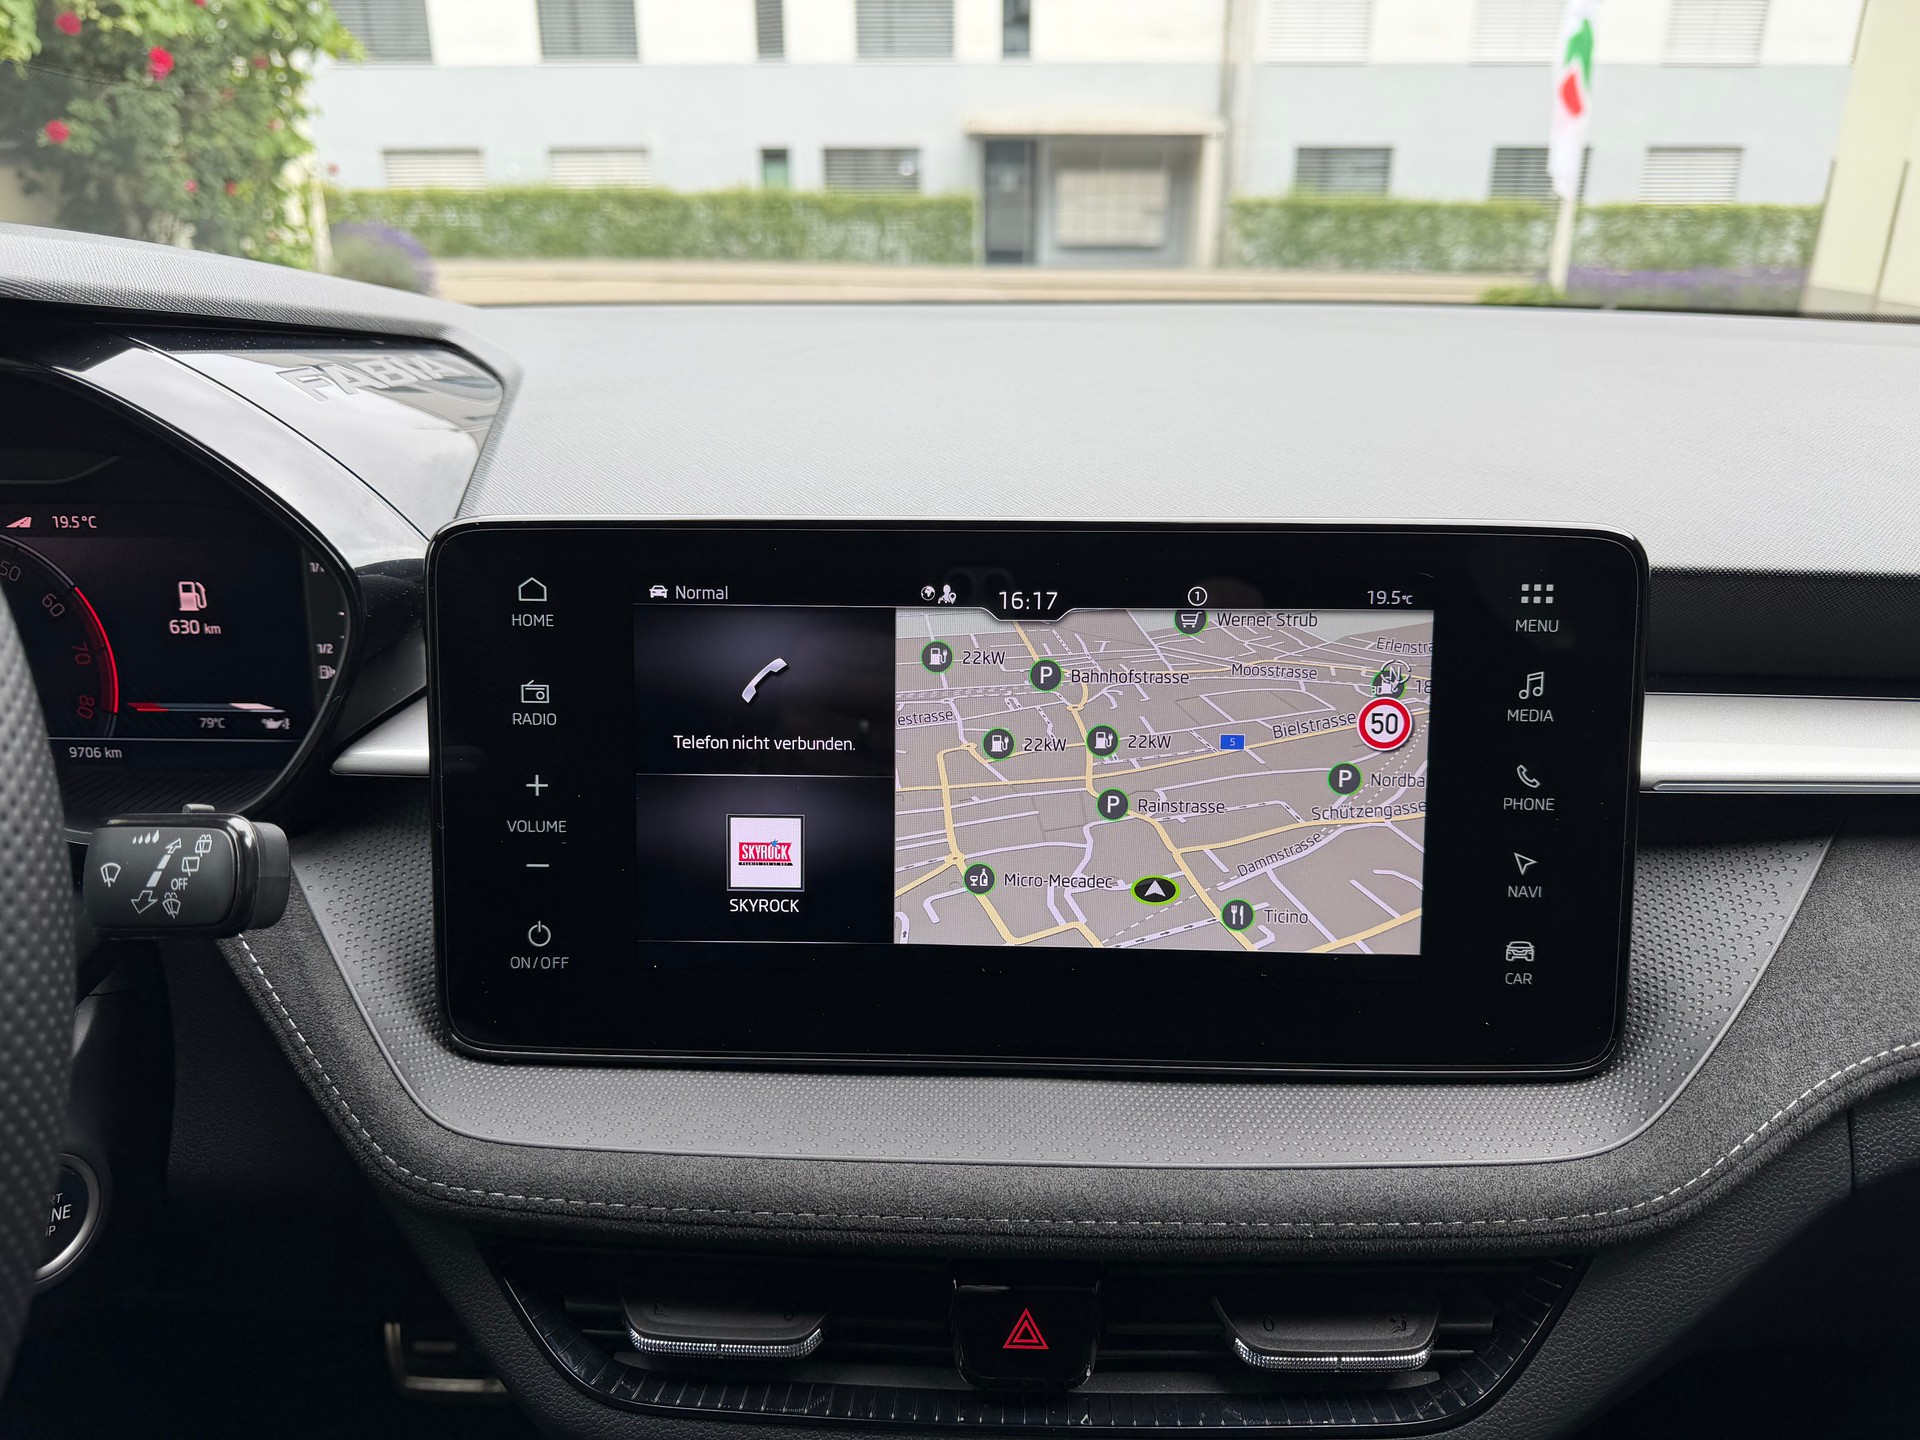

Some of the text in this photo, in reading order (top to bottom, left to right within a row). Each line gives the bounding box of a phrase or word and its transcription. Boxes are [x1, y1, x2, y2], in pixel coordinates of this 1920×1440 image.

[275, 355, 466, 402] FABIA
[52, 515, 97, 529] 19.5°C
[675, 584, 729, 601] Normal
[999, 591, 1058, 610] 16:17
[41, 593, 66, 617] 60
[511, 614, 555, 628] HOME
[1217, 611, 1318, 627] Werner Strub
[1515, 619, 1559, 633] MENU
[168, 620, 222, 635] 630 km
[71, 642, 92, 665] 70
[316, 643, 334, 654] 1/2
[962, 650, 1006, 666] 22kW
[1039, 667, 1053, 683] P
[1071, 668, 1189, 686] Bahnhofstrasse
[1231, 663, 1318, 680] Moosstrasse
[77, 695, 95, 719] 80
[200, 717, 226, 729] 79°C
[512, 713, 557, 727] RADIO
[897, 710, 954, 726] estrasse
[1370, 711, 1399, 735] 50
[1507, 709, 1554, 723] MEDIA
[1271, 712, 1358, 739] Bielstrasse
[673, 734, 857, 752] Telefon nicht verbunden.
[1023, 737, 1067, 752] 22kW
[1127, 734, 1172, 750] 22kW
[69, 747, 122, 760] 9706 km
[1338, 769, 1353, 788] P
[1370, 773, 1426, 787] Nordba
[1106, 795, 1121, 813] P
[1137, 797, 1226, 815] Rainstrasse
[1311, 801, 1427, 820] Schützengasse
[1503, 798, 1555, 811] PHONE
[506, 820, 567, 834] VOLUME
[741, 843, 788, 860] SKYROCK
[1236, 831, 1323, 877] Dammstrasse
[170, 877, 189, 892] OFF
[1003, 872, 1113, 890] Micro-Mecadec
[1507, 886, 1542, 898] NAVI
[729, 898, 800, 913] SKYROCK
[1264, 908, 1308, 925] Ticino
[510, 956, 569, 970] ON/OFF
[1505, 973, 1532, 986] CAR
